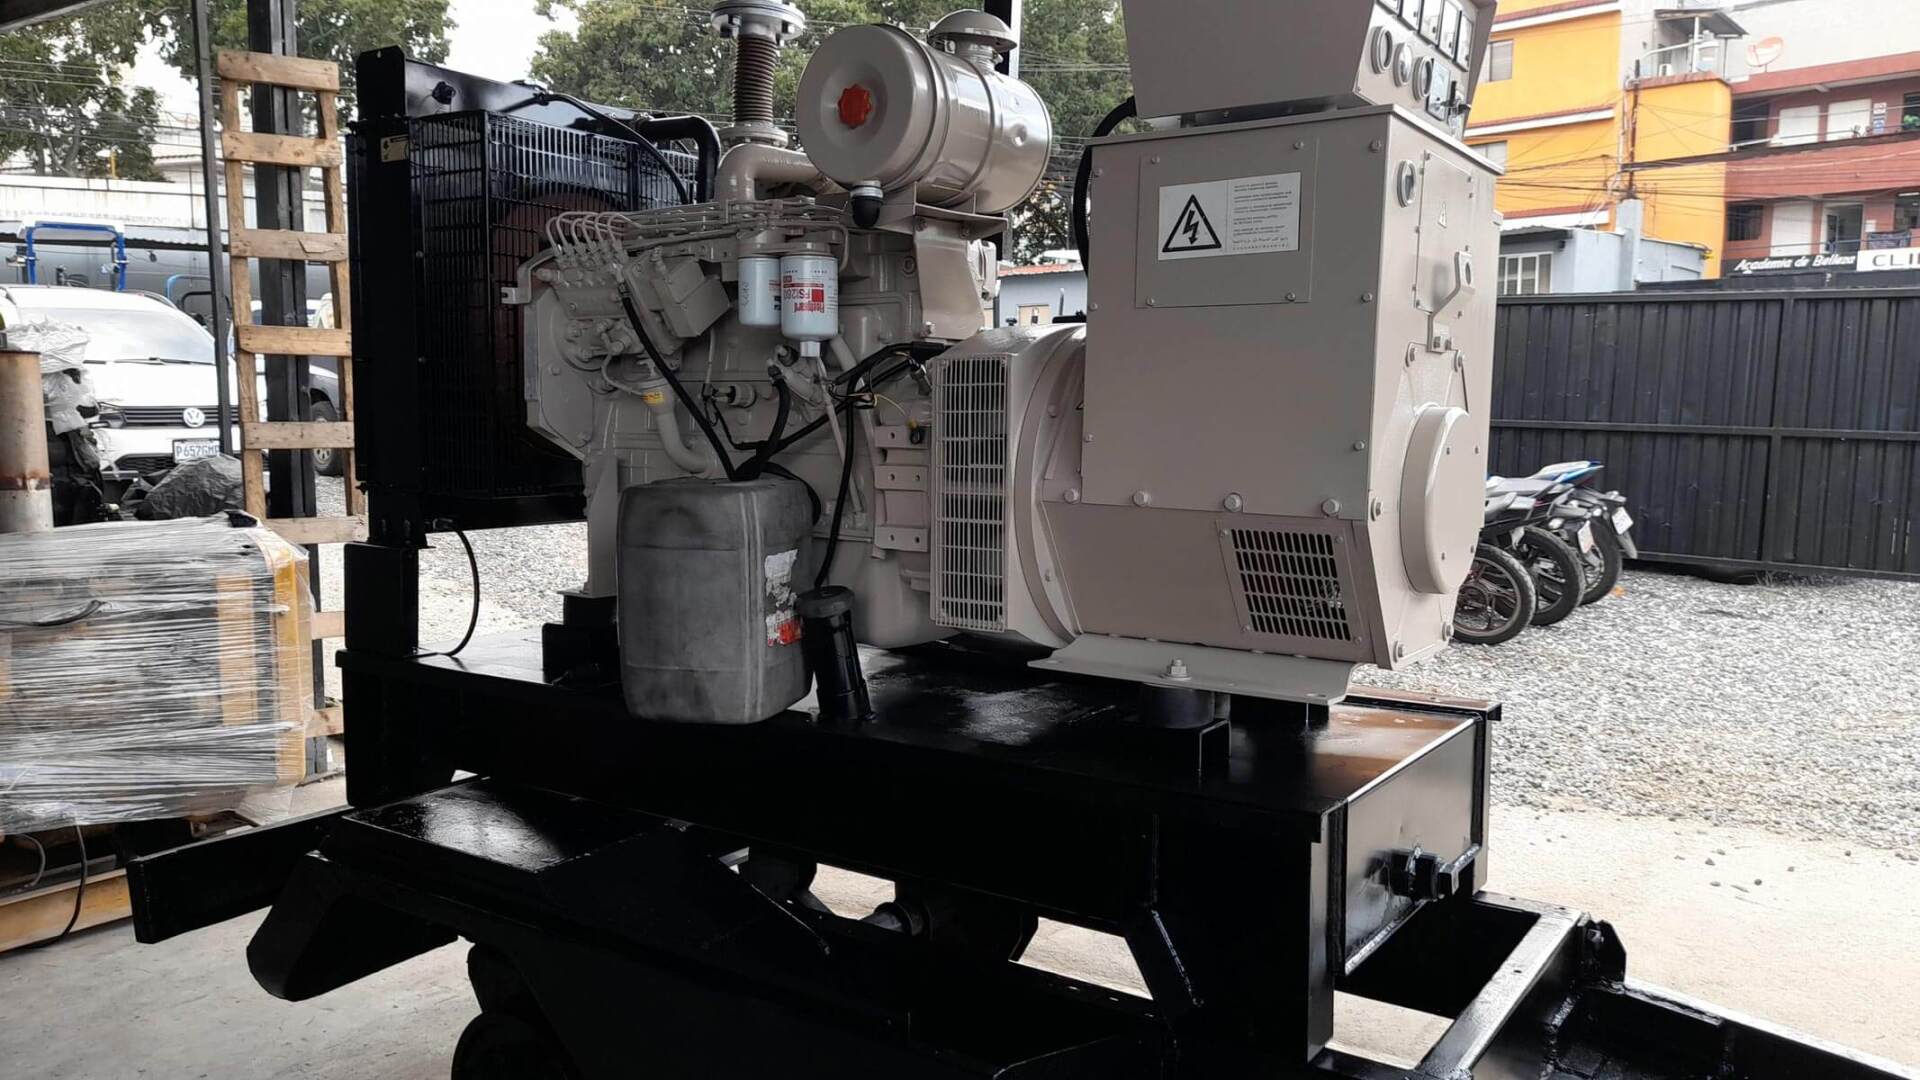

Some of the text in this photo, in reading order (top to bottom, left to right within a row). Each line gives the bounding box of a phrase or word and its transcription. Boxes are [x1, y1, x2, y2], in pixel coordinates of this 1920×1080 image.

[1734, 254, 1856, 270] Academia de Belleza
